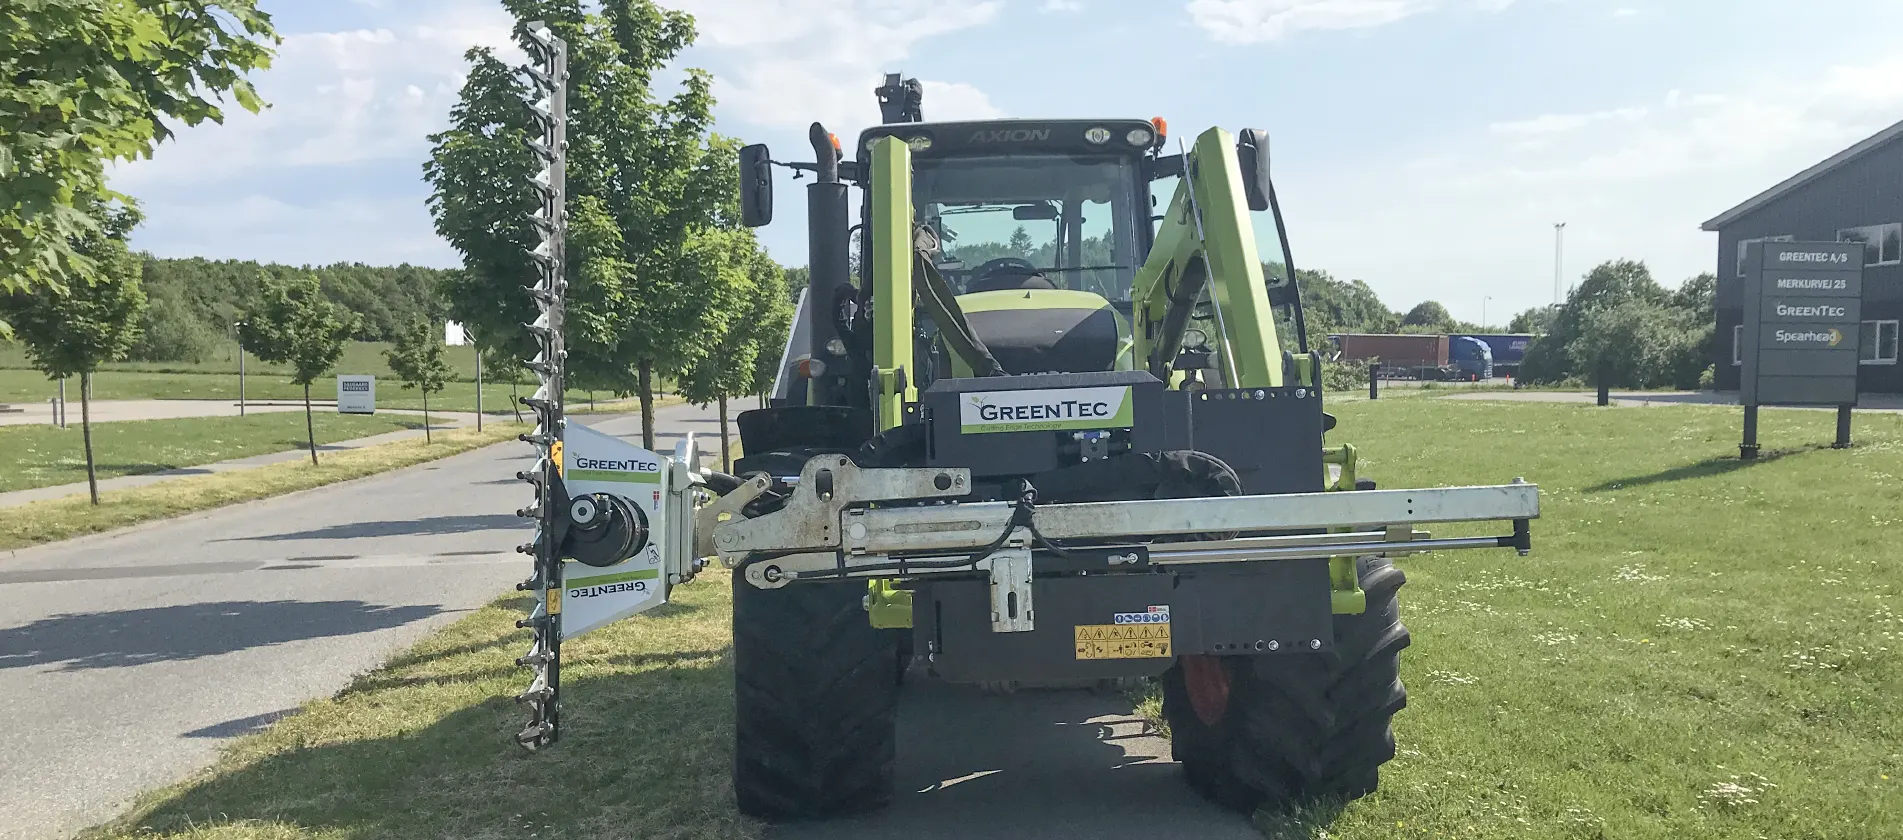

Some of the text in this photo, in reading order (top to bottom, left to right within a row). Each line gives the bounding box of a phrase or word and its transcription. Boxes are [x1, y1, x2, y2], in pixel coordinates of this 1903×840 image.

[968, 129, 1050, 143] AXION
[1779, 252, 1848, 264] GREENTEC A/S
[1777, 279, 1847, 289] MERKURVEJ 25
[1775, 329, 1837, 343] Spearhead
[1005, 423, 1023, 431] Edge
[1023, 422, 1063, 431] Technology
